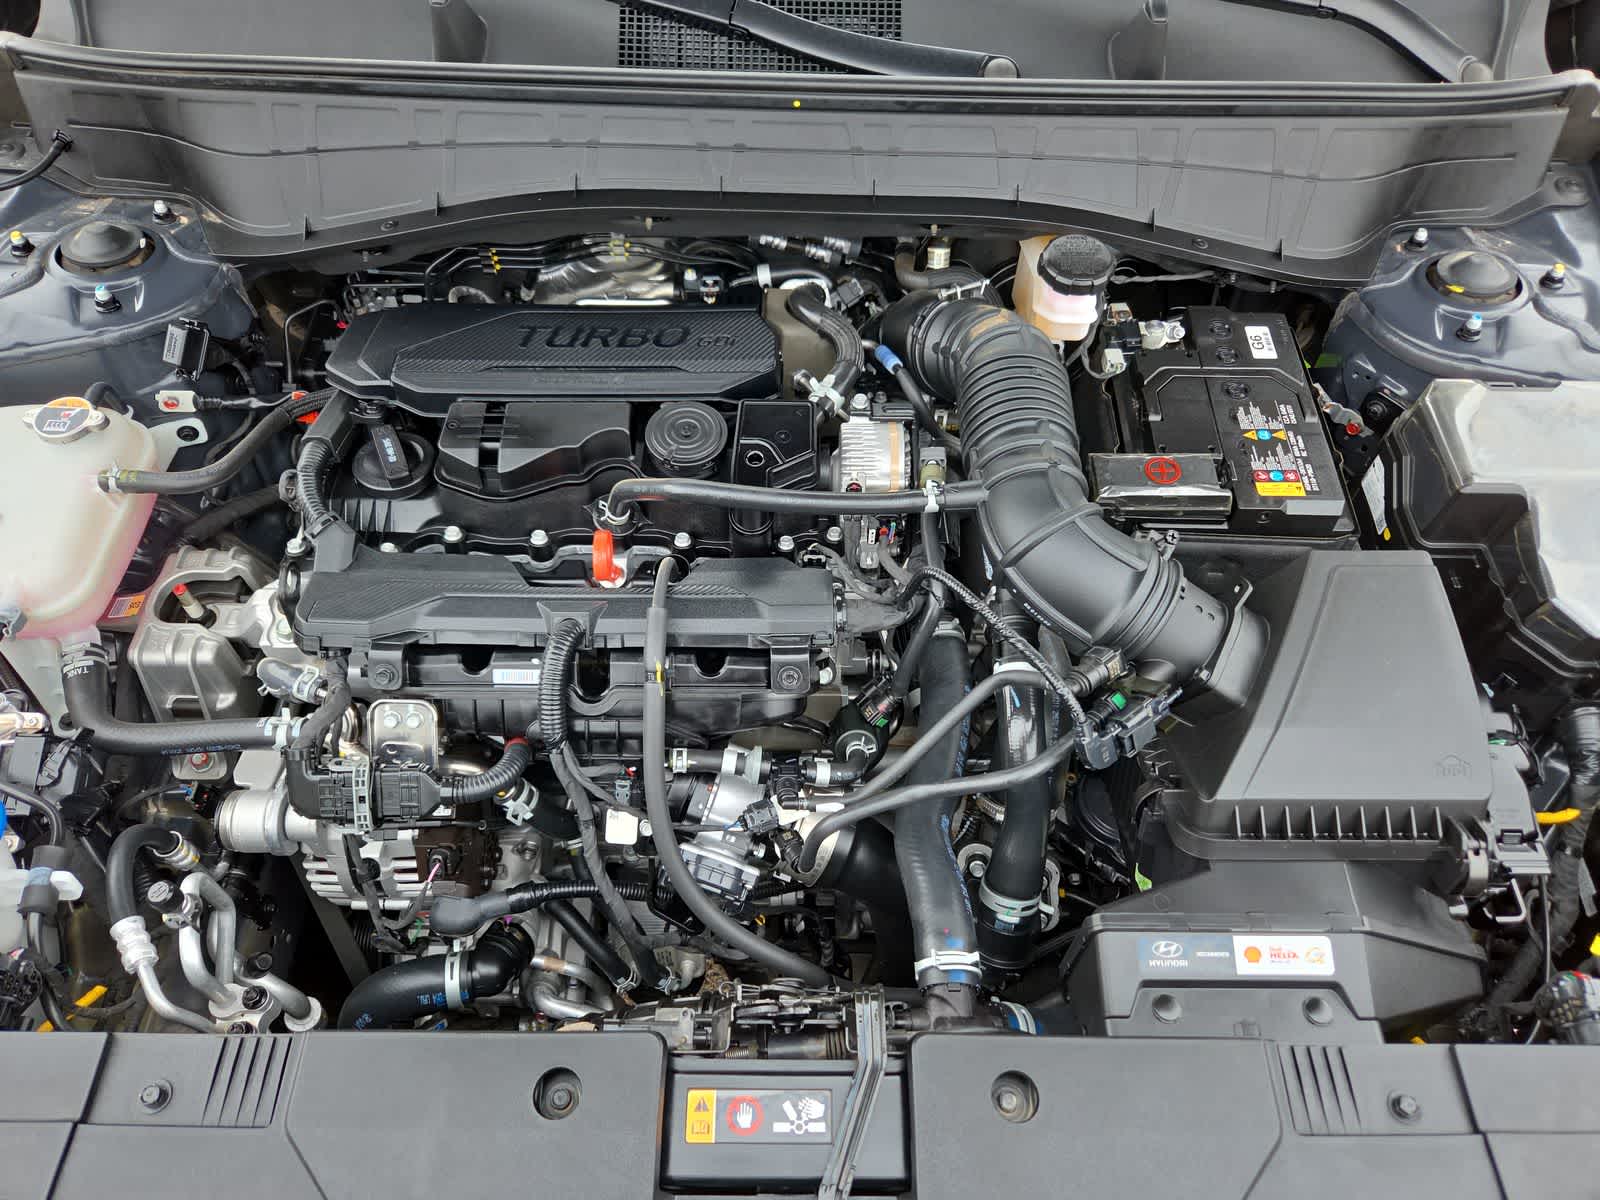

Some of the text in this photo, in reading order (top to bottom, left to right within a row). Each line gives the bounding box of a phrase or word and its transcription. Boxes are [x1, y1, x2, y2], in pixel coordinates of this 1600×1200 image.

[516, 325, 738, 349] TURBO GDi
[1250, 335, 1265, 350] G6
[67, 666, 89, 679] TANK
[1148, 959, 1189, 969] HYUNDAI
